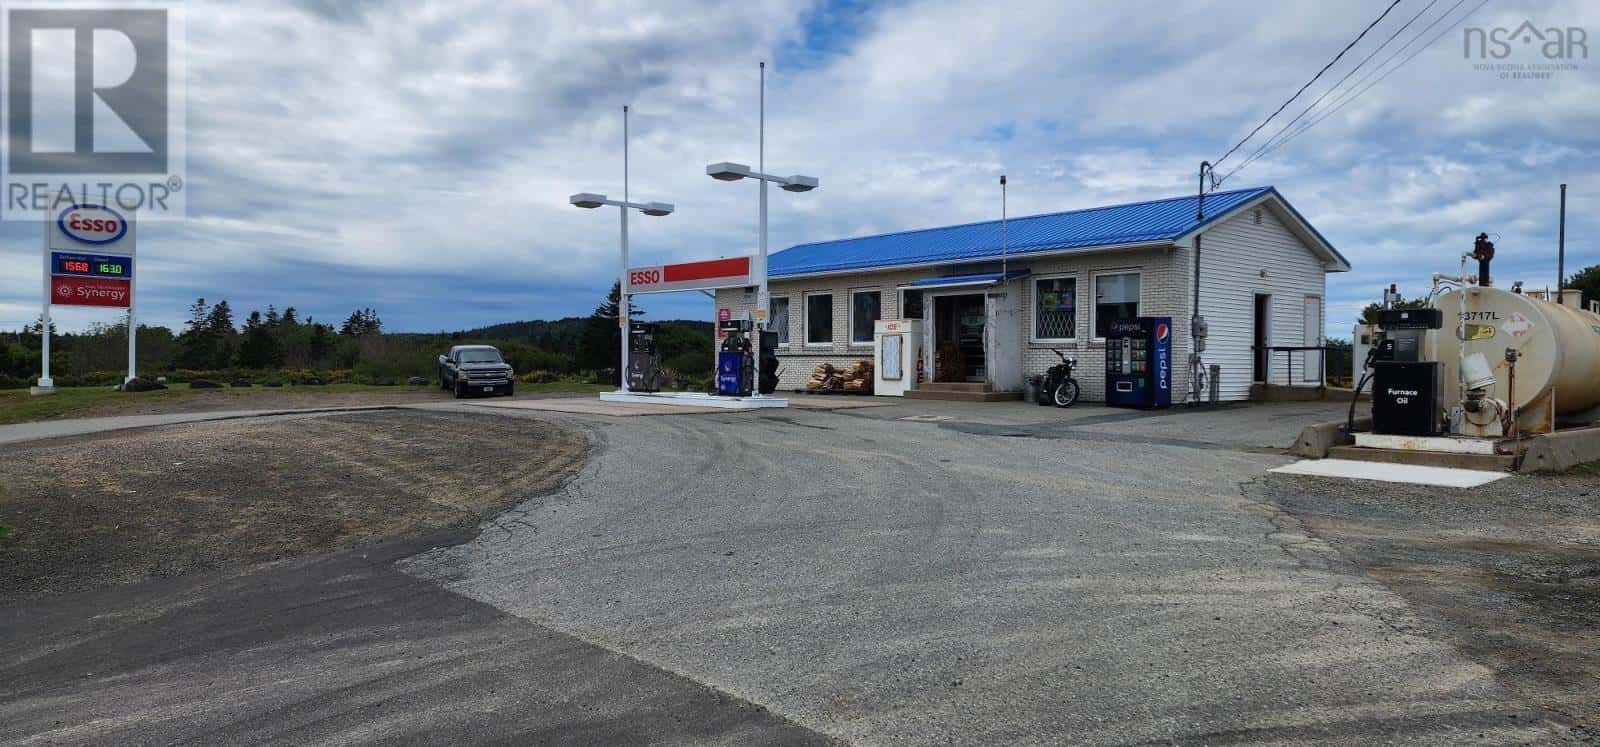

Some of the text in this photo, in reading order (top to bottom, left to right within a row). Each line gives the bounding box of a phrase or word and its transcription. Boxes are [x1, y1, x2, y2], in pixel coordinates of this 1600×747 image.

[630, 270, 660, 285] ESSO
[76, 286, 125, 300] Synergy
[1159, 348, 1169, 390] pepsi
[1387, 387, 1418, 396] Furnace
[1396, 396, 1409, 404] Oil
